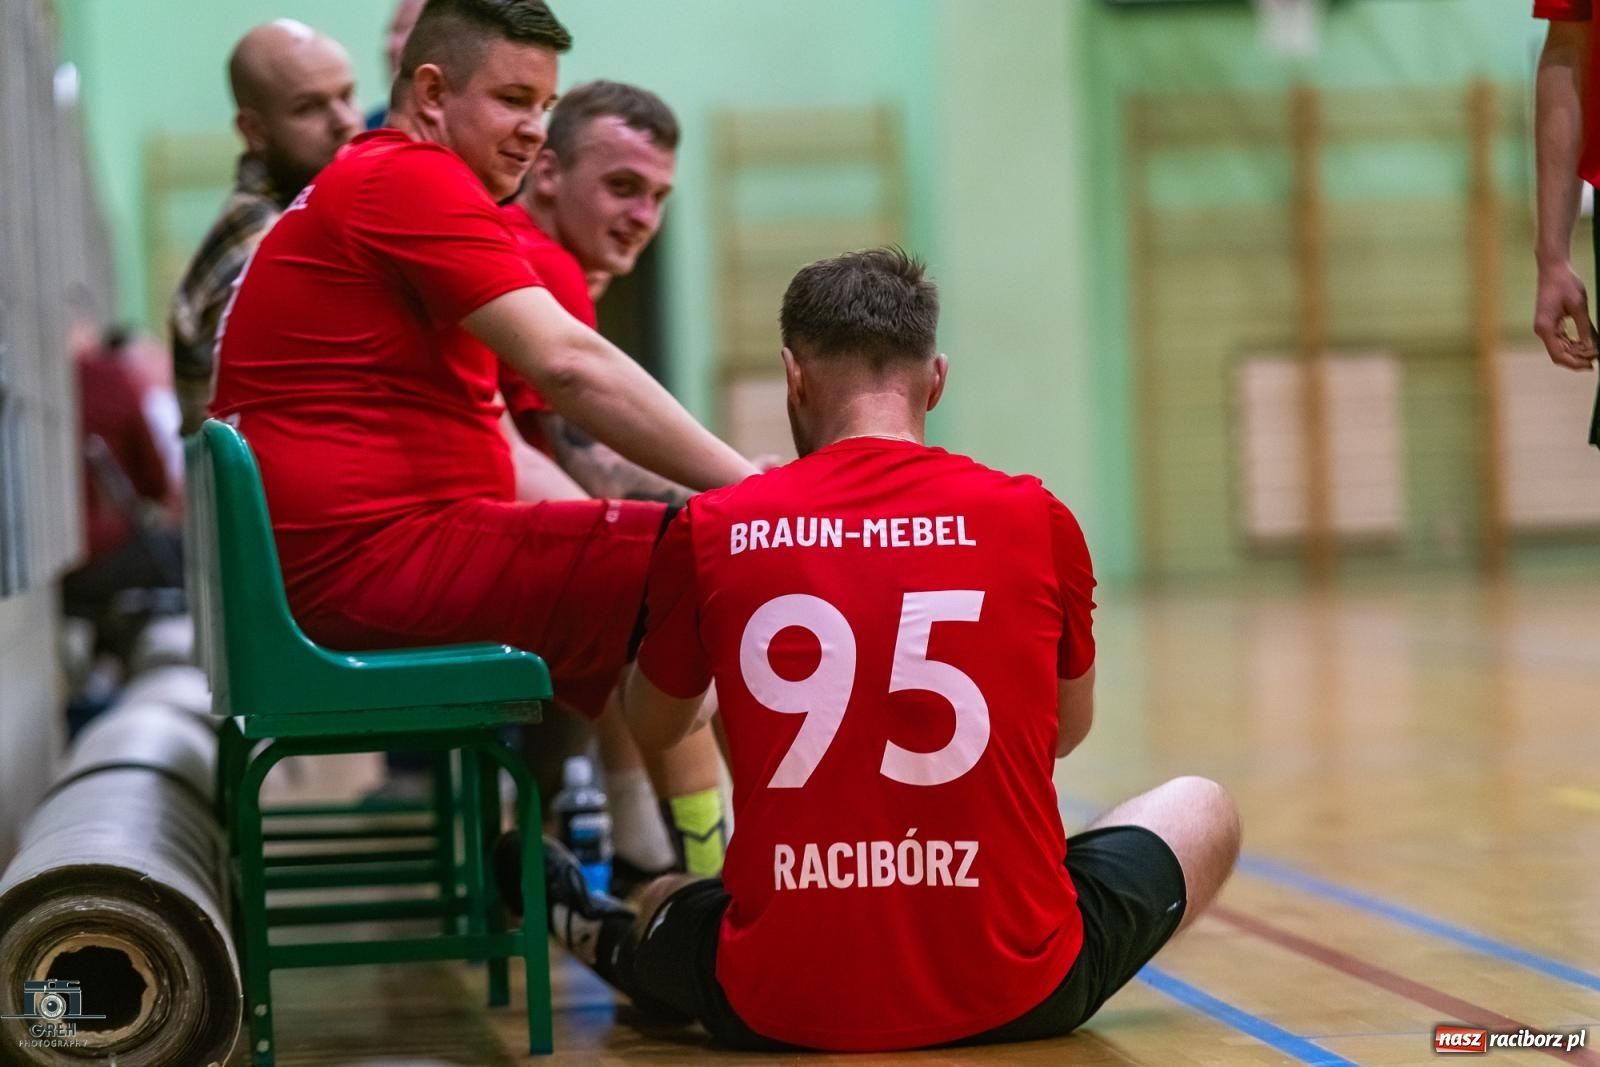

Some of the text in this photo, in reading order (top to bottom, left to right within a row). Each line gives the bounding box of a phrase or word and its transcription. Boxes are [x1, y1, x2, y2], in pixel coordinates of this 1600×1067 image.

[730, 515, 977, 556] BRAUN-MEBEL
[739, 589, 991, 789] 95
[774, 828, 980, 891] RACIBÓRZ
